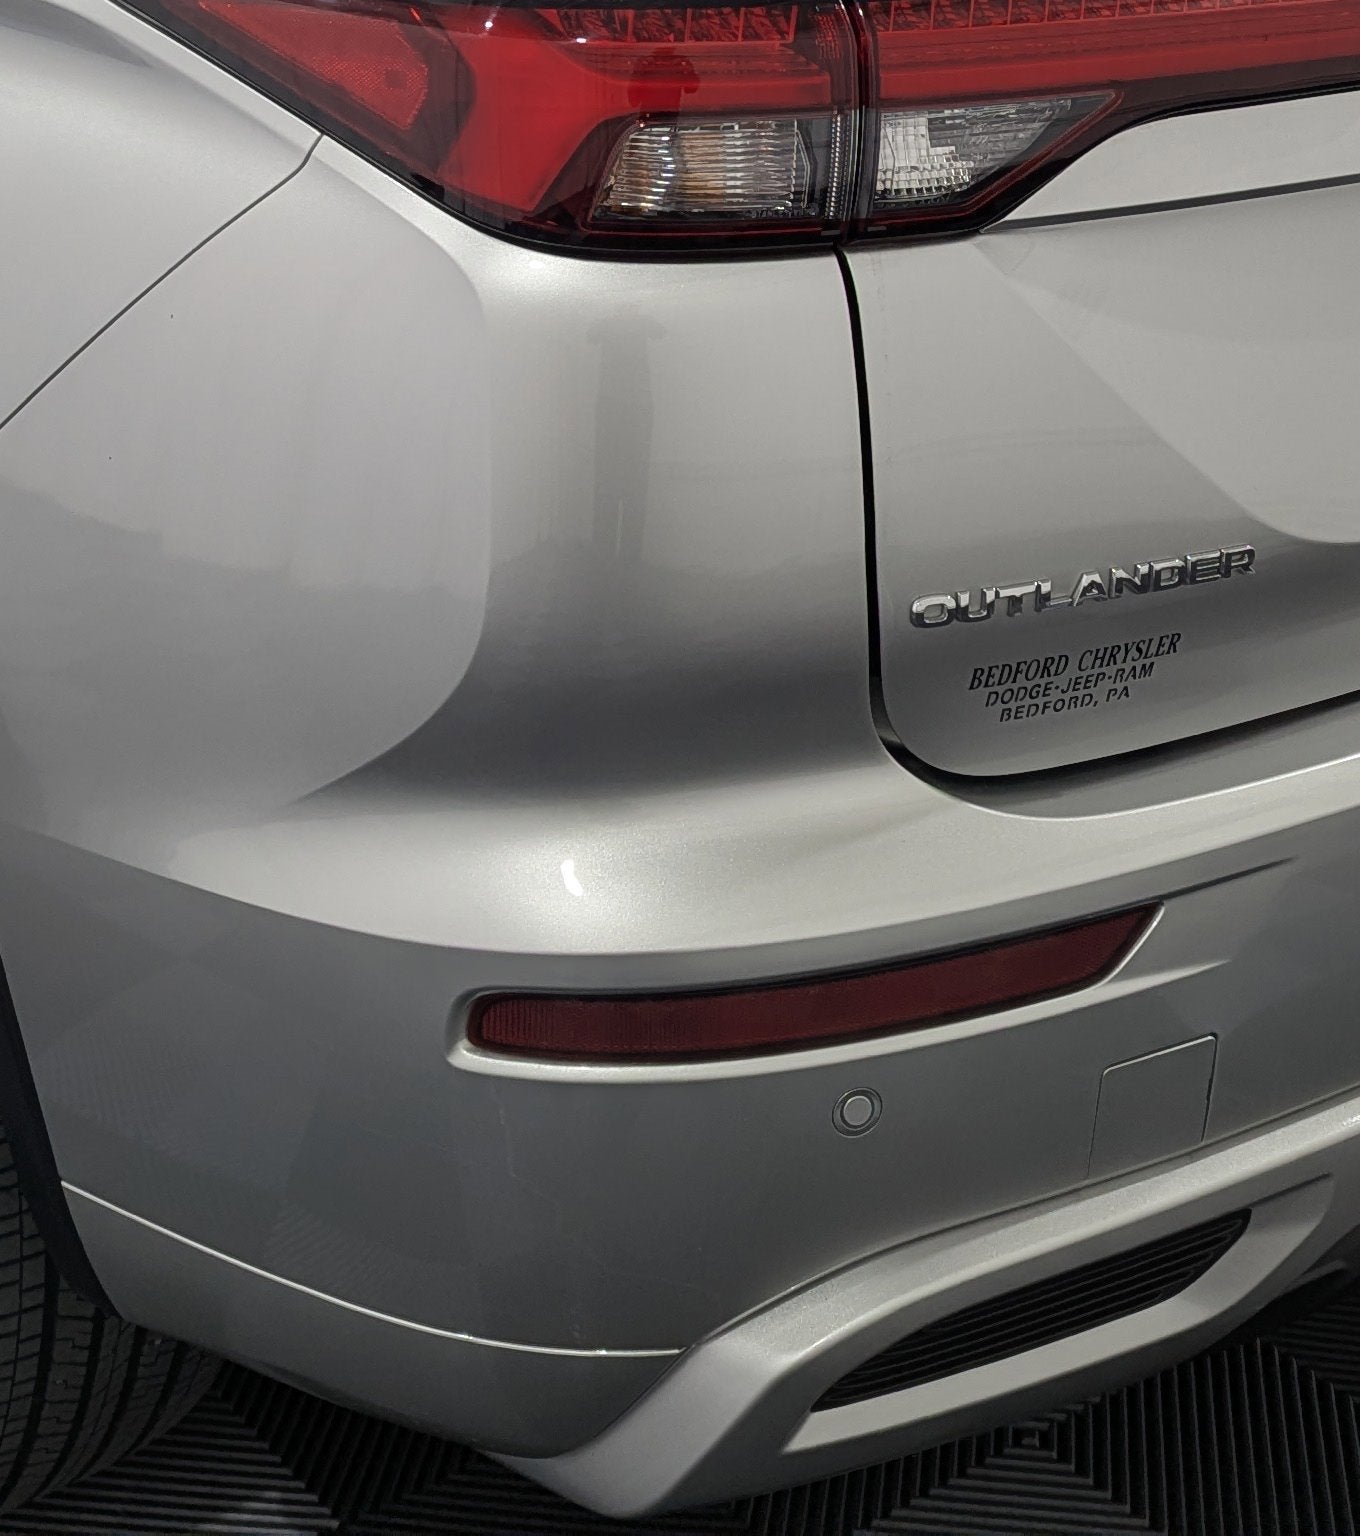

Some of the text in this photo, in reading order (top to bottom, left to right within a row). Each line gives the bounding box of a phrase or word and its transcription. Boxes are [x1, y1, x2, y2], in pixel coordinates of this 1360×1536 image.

[909, 544, 1256, 628] OUTLANDER
[968, 632, 1182, 690] BEDFORD CHRYSLER
[999, 685, 1131, 722] BEDFORD, PA
